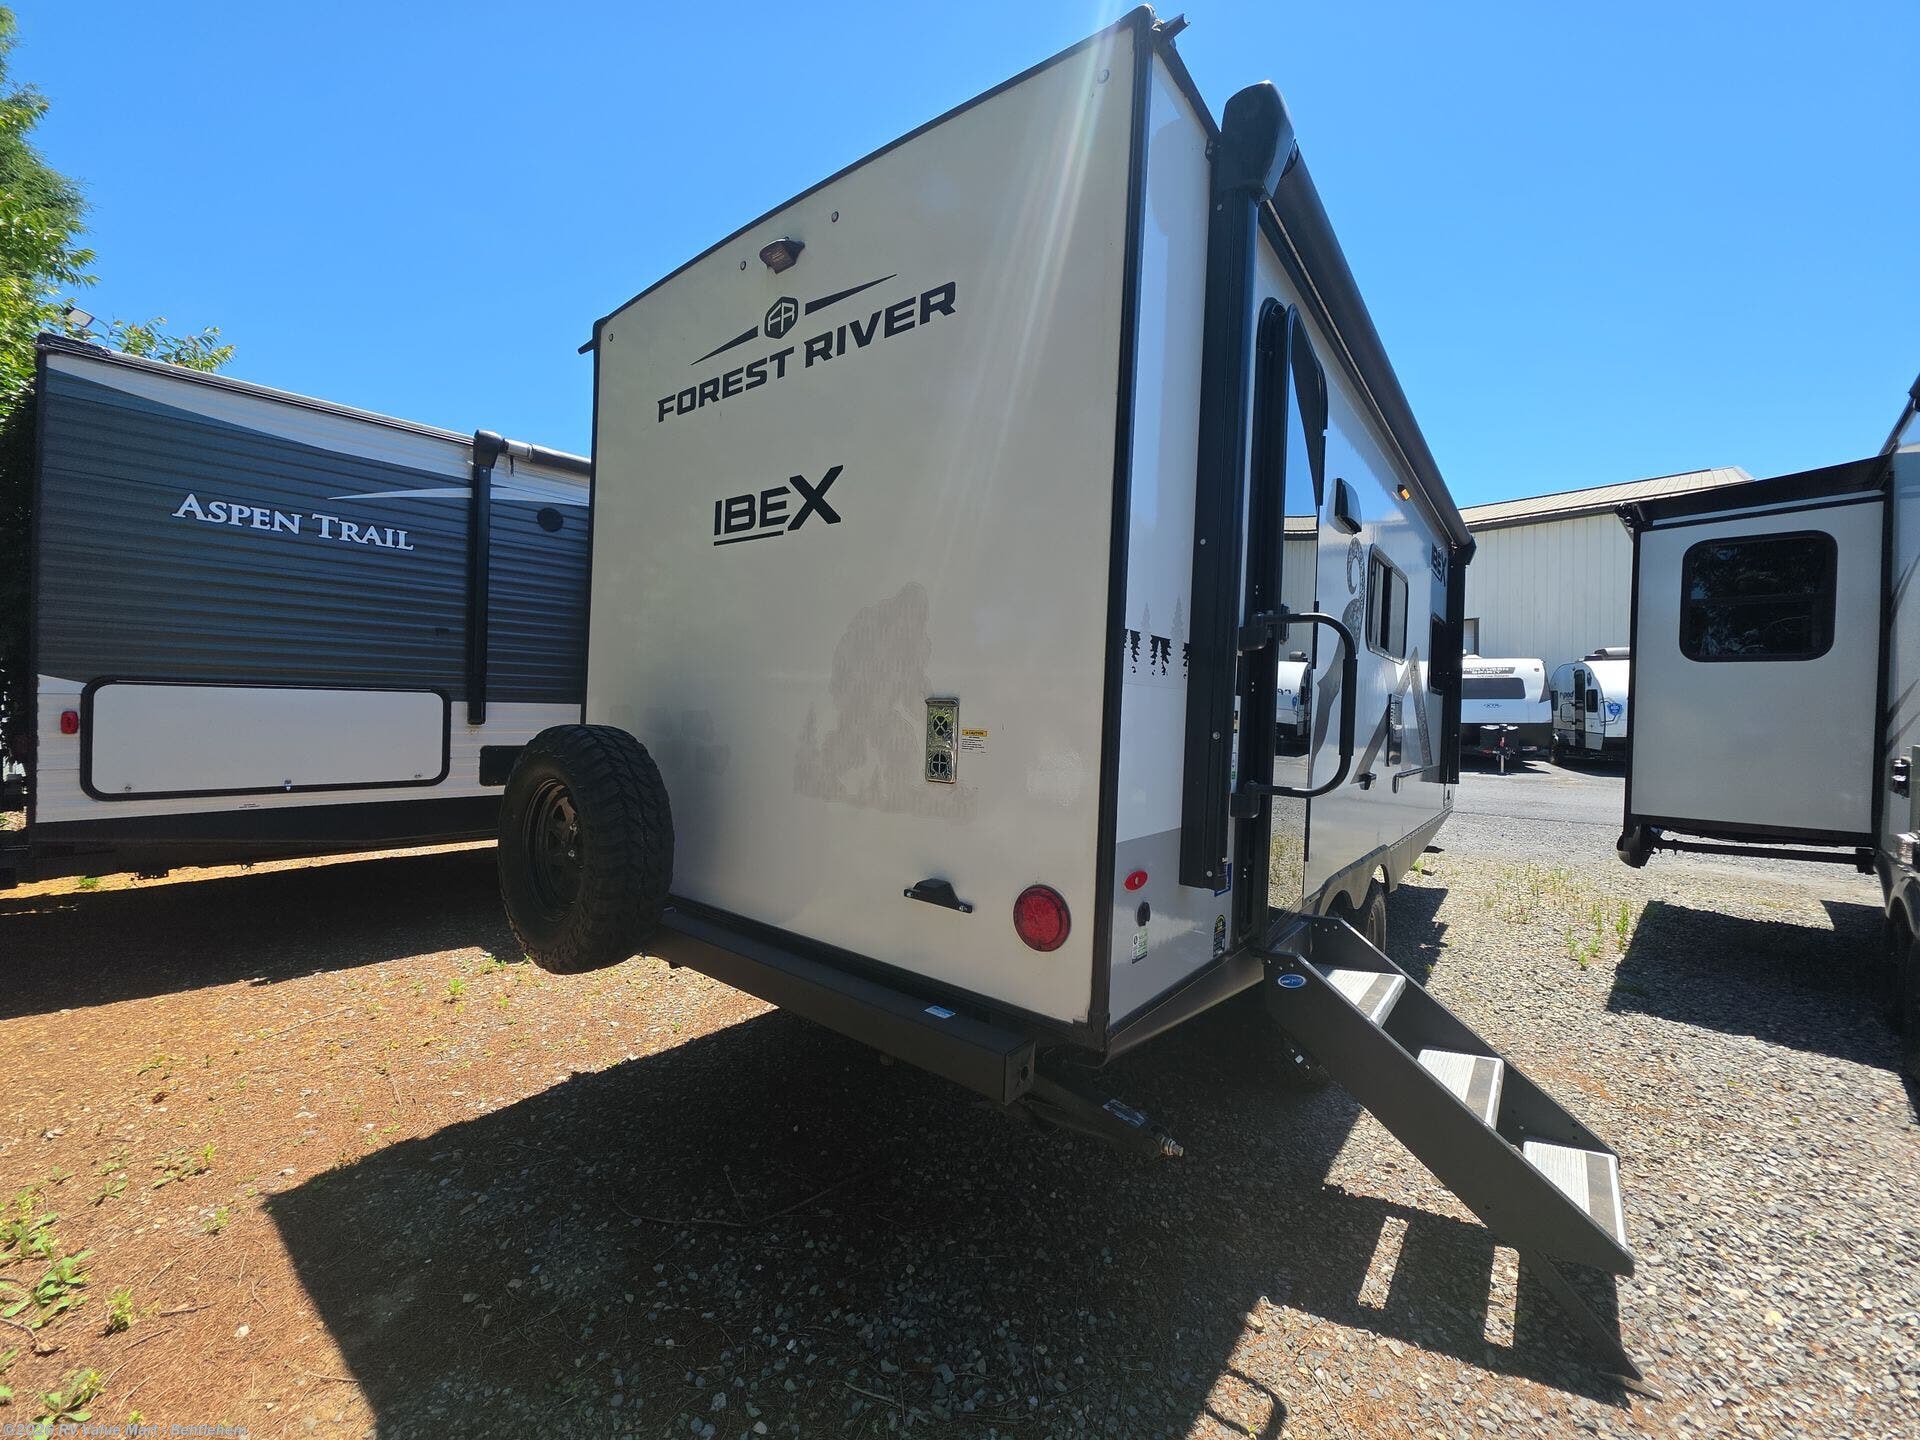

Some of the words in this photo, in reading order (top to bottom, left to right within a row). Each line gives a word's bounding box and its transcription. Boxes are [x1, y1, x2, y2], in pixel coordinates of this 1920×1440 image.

[657, 346, 795, 423] FOREST
[803, 281, 957, 368] RIVER
[171, 493, 302, 535] ASPEN
[311, 513, 414, 551] TRAIL
[713, 464, 844, 536] IBEX
